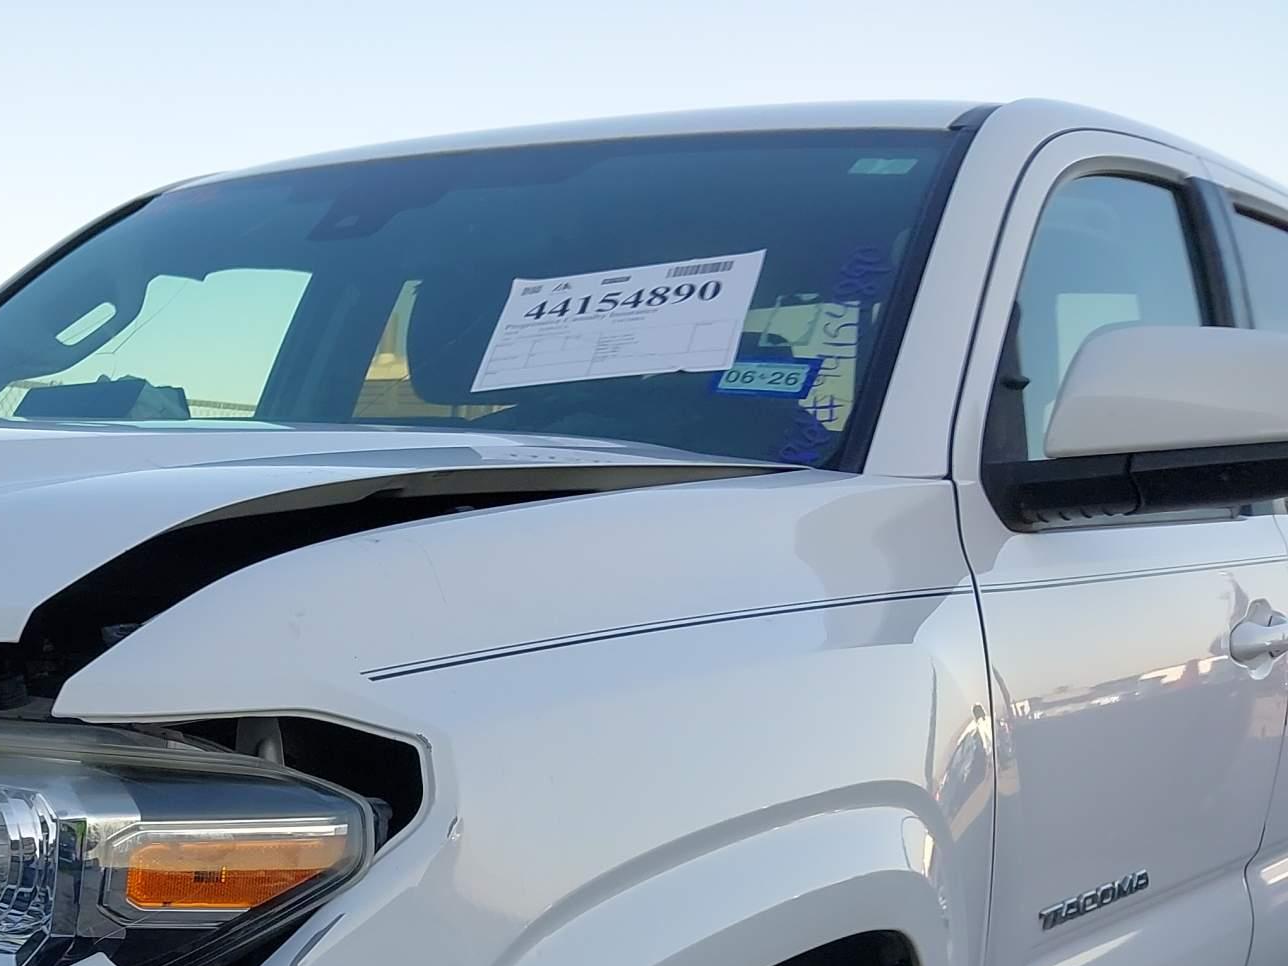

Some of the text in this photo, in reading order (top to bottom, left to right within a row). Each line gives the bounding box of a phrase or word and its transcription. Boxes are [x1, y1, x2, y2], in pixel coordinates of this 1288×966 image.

[523, 279, 722, 321] 44154890
[726, 370, 800, 386] 06 26
[1038, 868, 1149, 931] TACOMA
